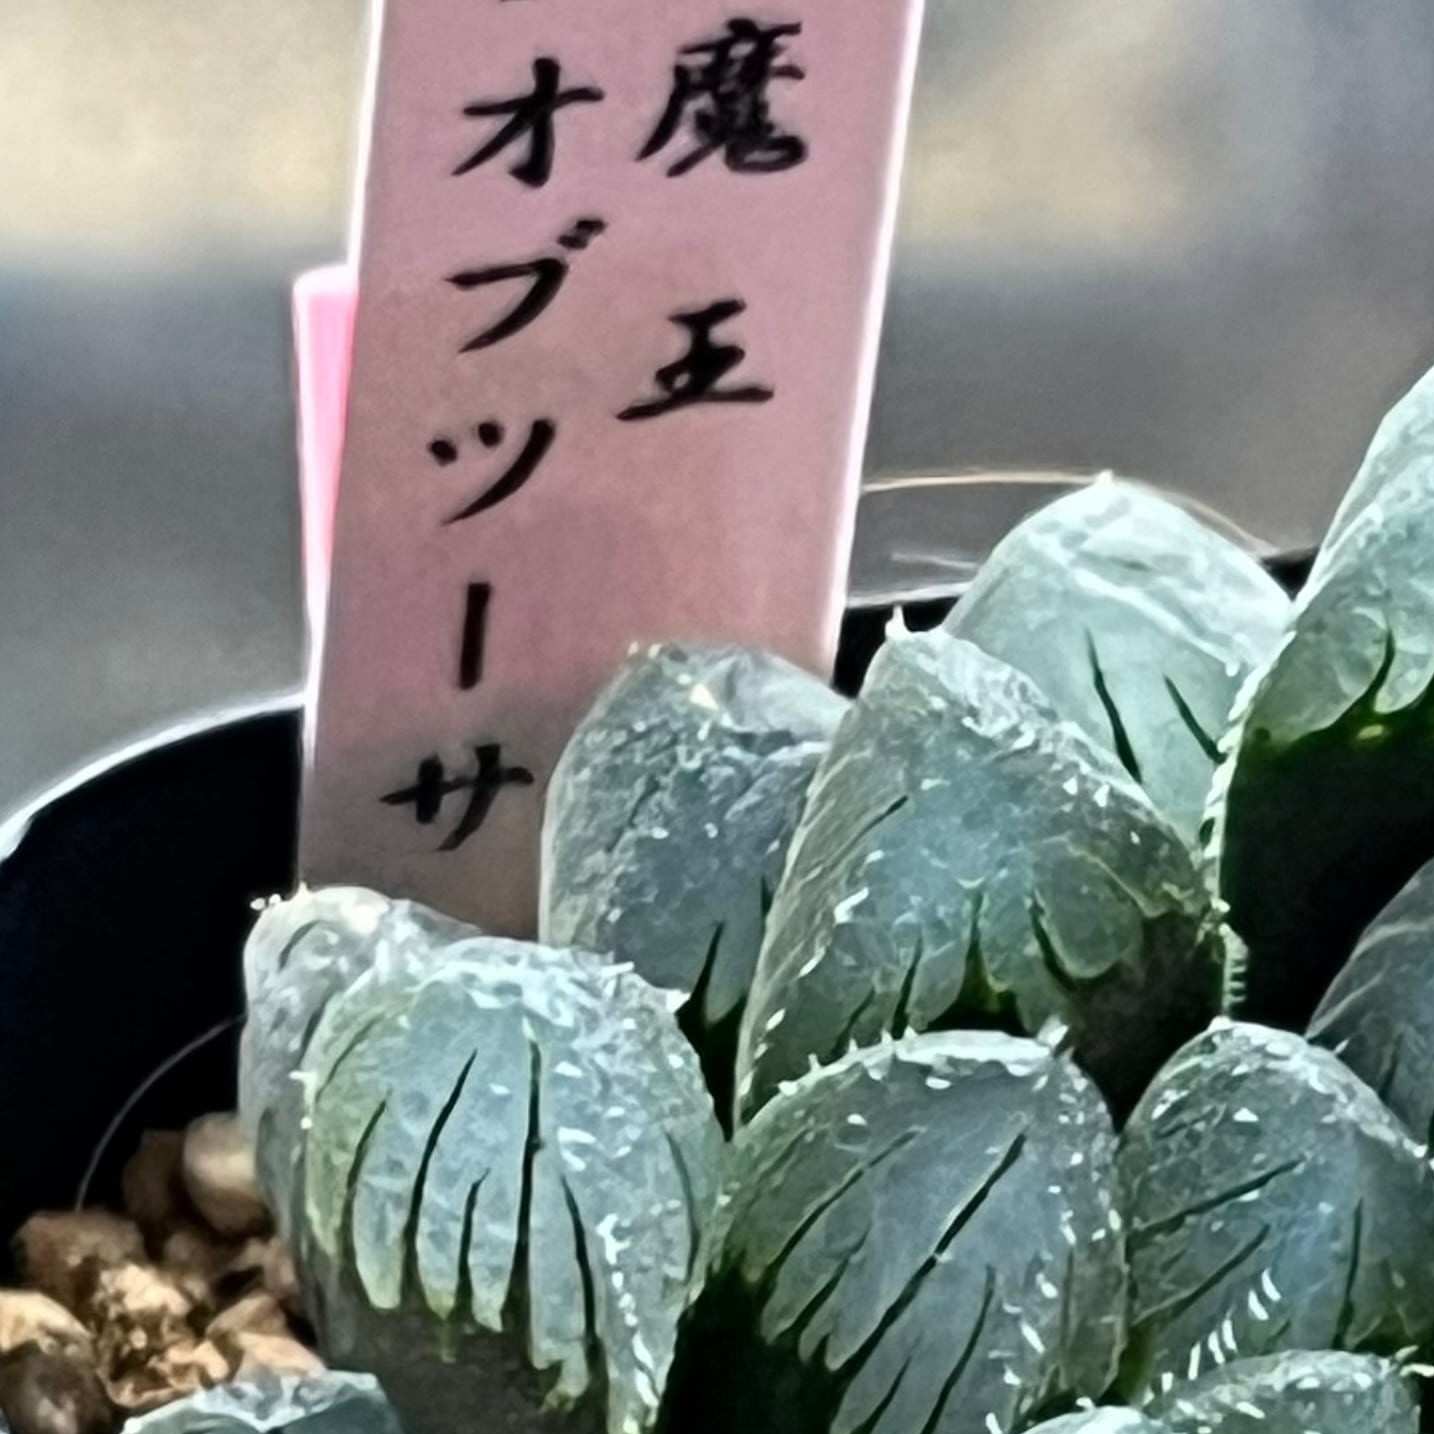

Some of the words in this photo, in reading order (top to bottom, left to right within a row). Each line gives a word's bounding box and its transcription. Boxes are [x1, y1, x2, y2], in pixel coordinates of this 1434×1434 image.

[378, 0, 606, 853] オブツーサ
[615, 17, 807, 422] 魔王
